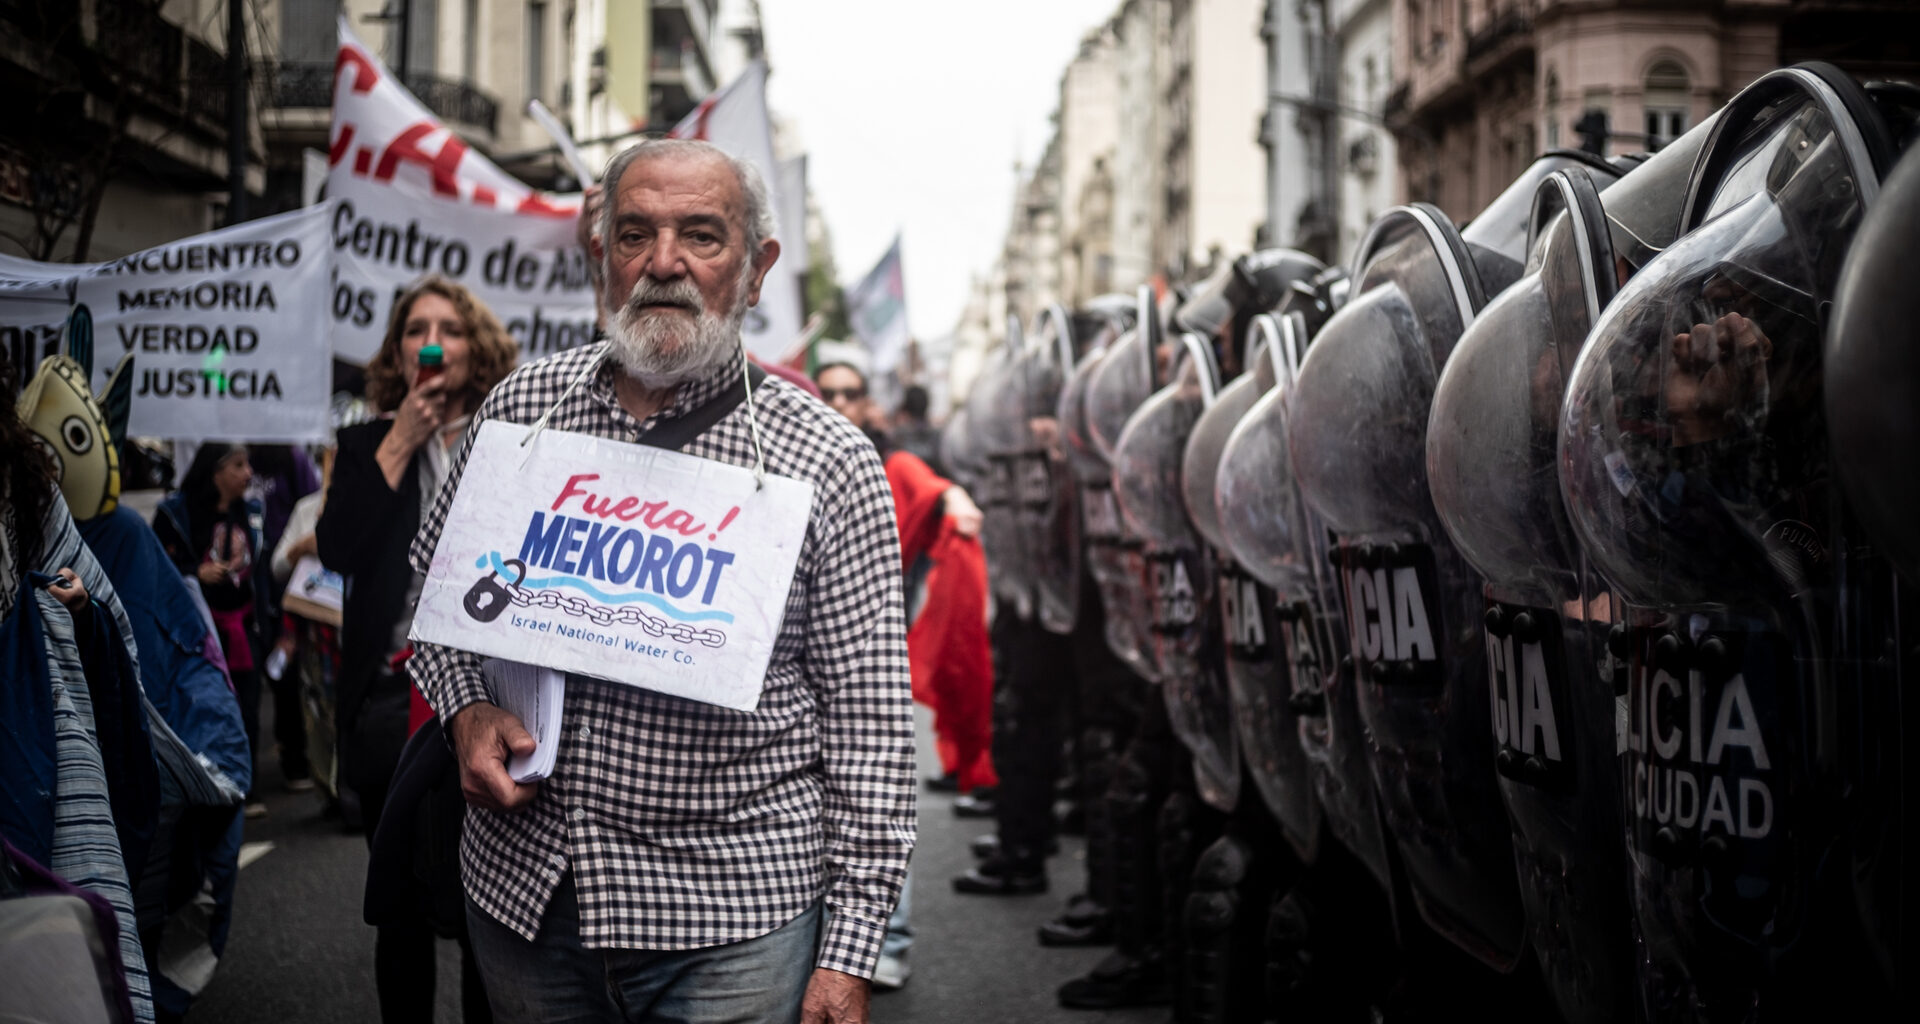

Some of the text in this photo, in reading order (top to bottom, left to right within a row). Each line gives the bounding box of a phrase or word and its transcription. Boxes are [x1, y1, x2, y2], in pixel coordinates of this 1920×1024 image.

[332, 199, 470, 278] Centro
[481, 237, 539, 293] de
[117, 281, 277, 312] MEMORIA
[117, 323, 259, 353] VERDAD
[137, 367, 282, 399] JUSTICIA
[551, 473, 741, 541] Fuera!
[518, 510, 735, 606] MEKOROT
[511, 614, 696, 665] Israel National Water Co.
[1485, 624, 1562, 762] CIA
[1634, 758, 1774, 840] CIUDAD
